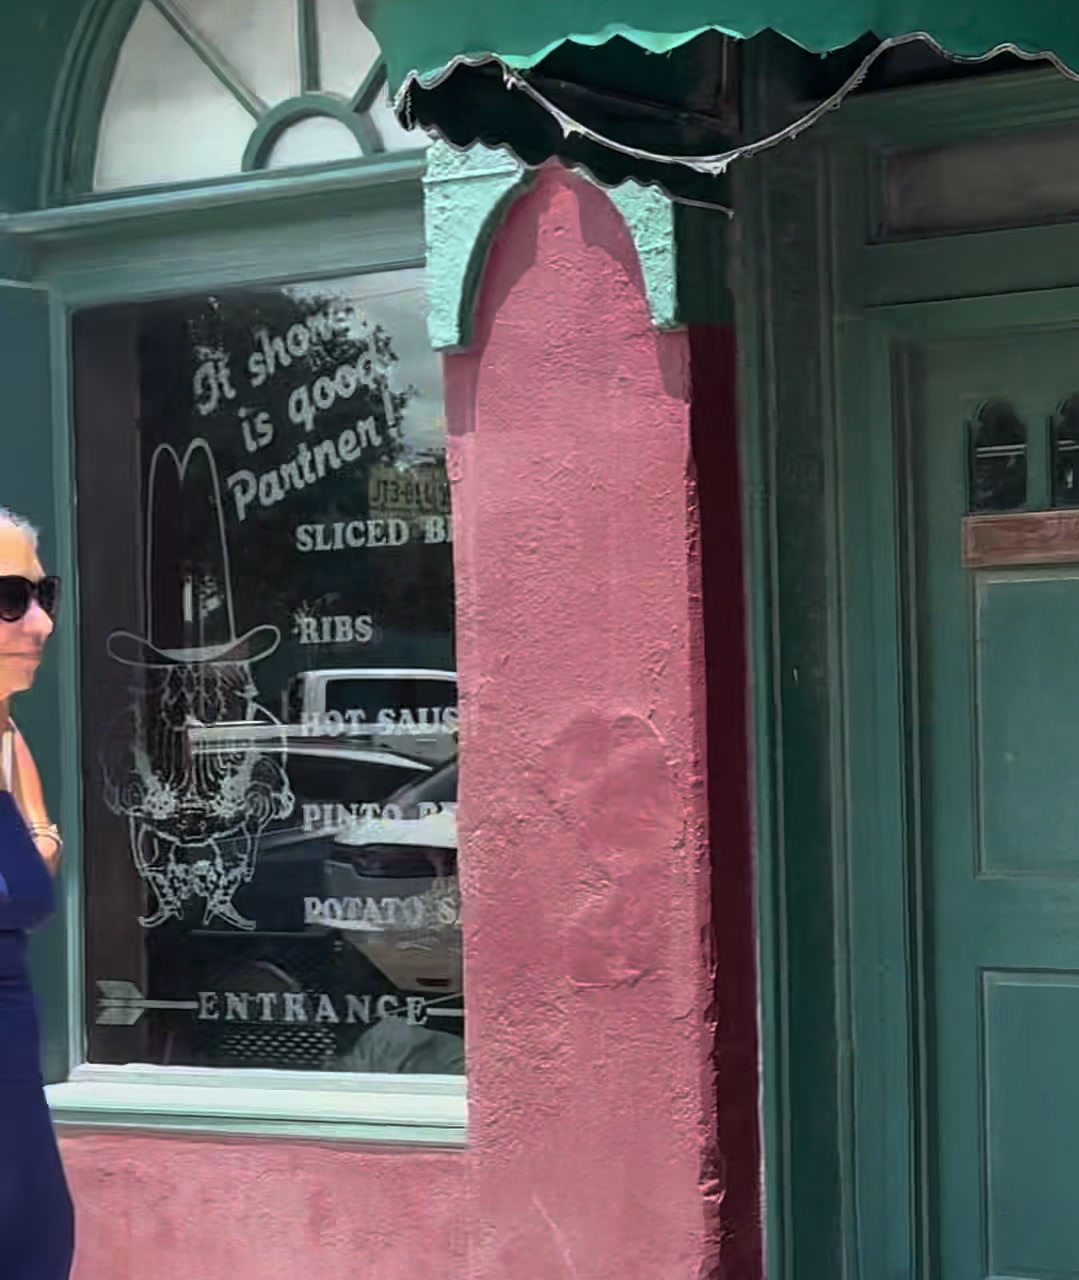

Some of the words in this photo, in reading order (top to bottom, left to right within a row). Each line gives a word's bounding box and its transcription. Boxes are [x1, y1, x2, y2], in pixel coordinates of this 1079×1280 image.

[192, 360, 237, 416] It
[238, 406, 274, 453] is
[288, 334, 378, 433] good
[295, 519, 409, 552] SLICED
[300, 615, 373, 644] RIBS
[300, 709, 366, 737] HOT
[302, 802, 402, 832] PINTO
[304, 896, 424, 926] POTATO
[198, 991, 428, 1025] ENTRANCE
